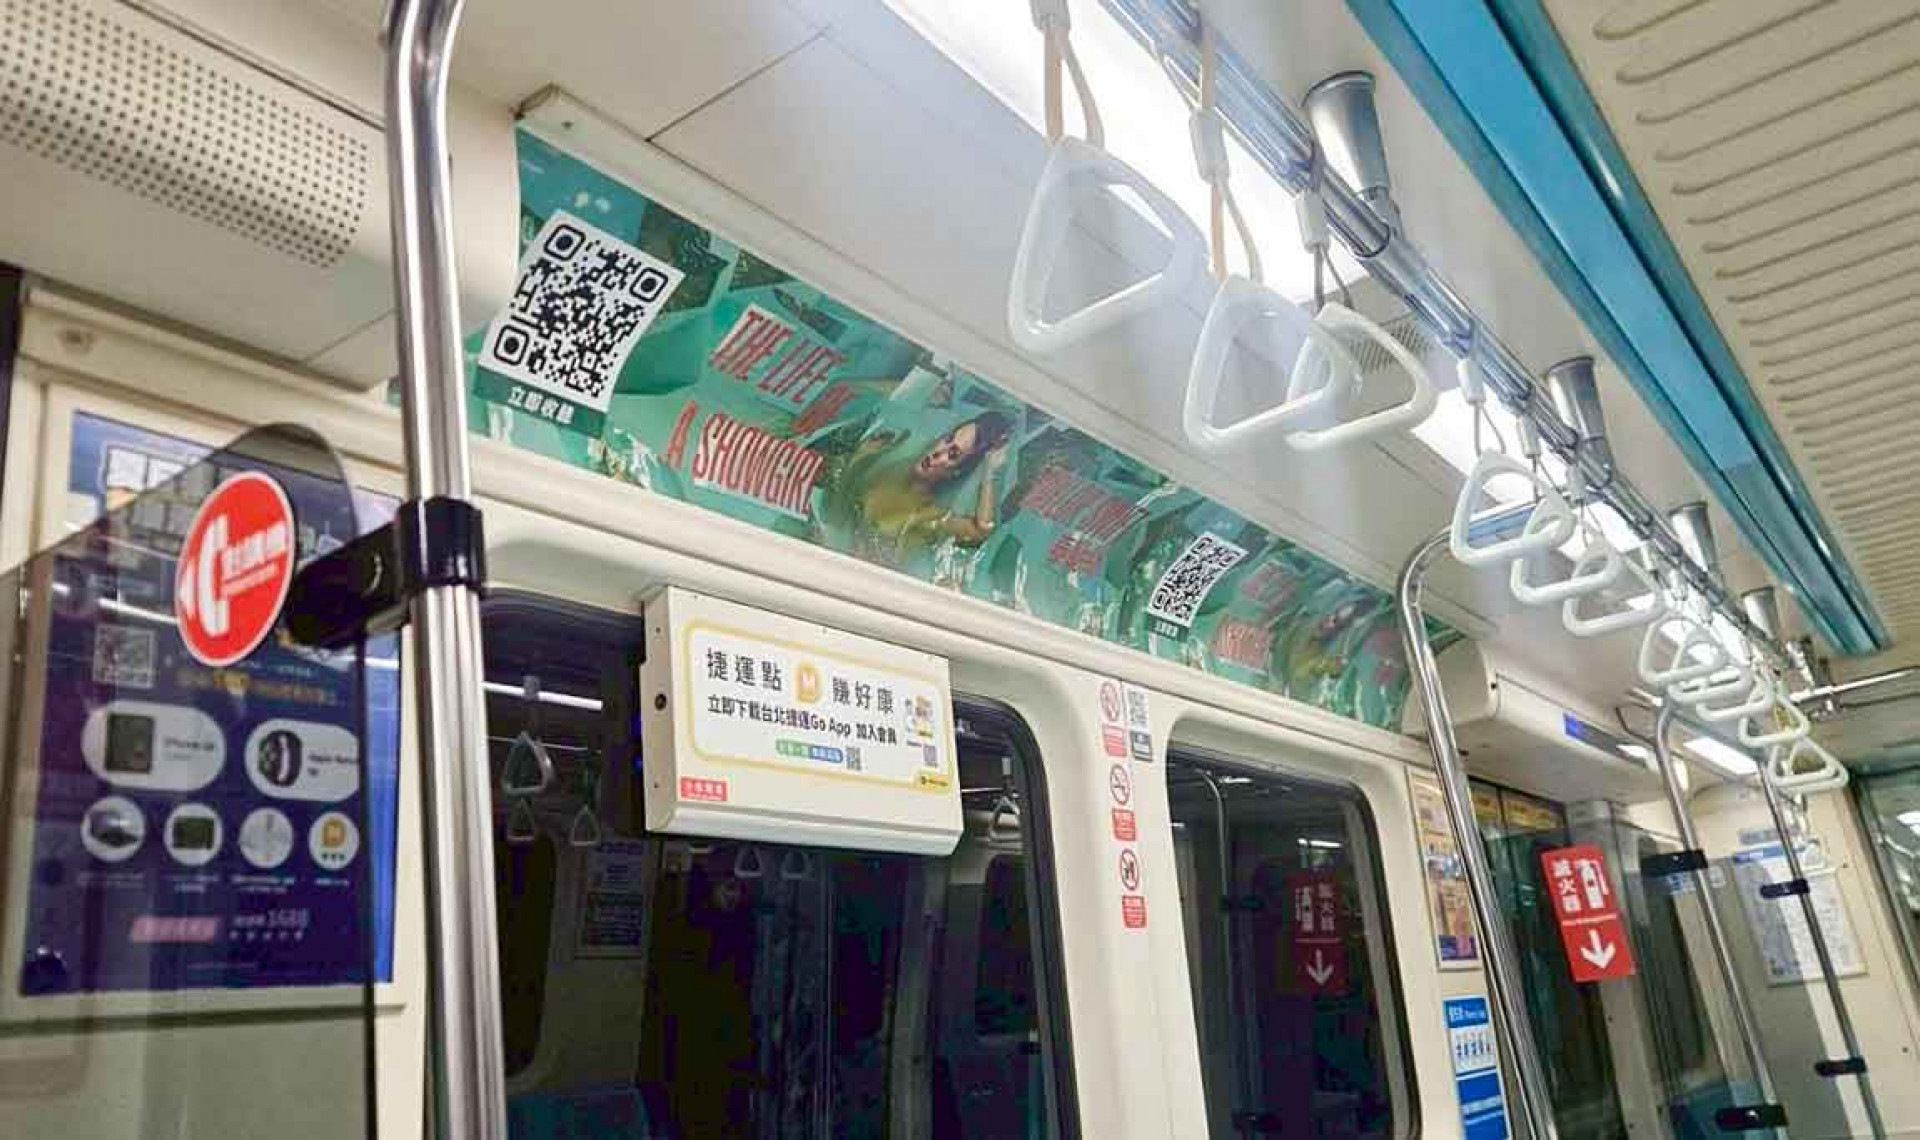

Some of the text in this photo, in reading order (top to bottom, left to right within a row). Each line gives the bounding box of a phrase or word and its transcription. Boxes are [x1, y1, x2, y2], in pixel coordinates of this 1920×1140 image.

[709, 309, 794, 381] THE
[757, 338, 845, 403] LIFE
[667, 400, 827, 515] A SHOWGIRL
[707, 647, 782, 691] 捷運點
[828, 717, 851, 737] App
